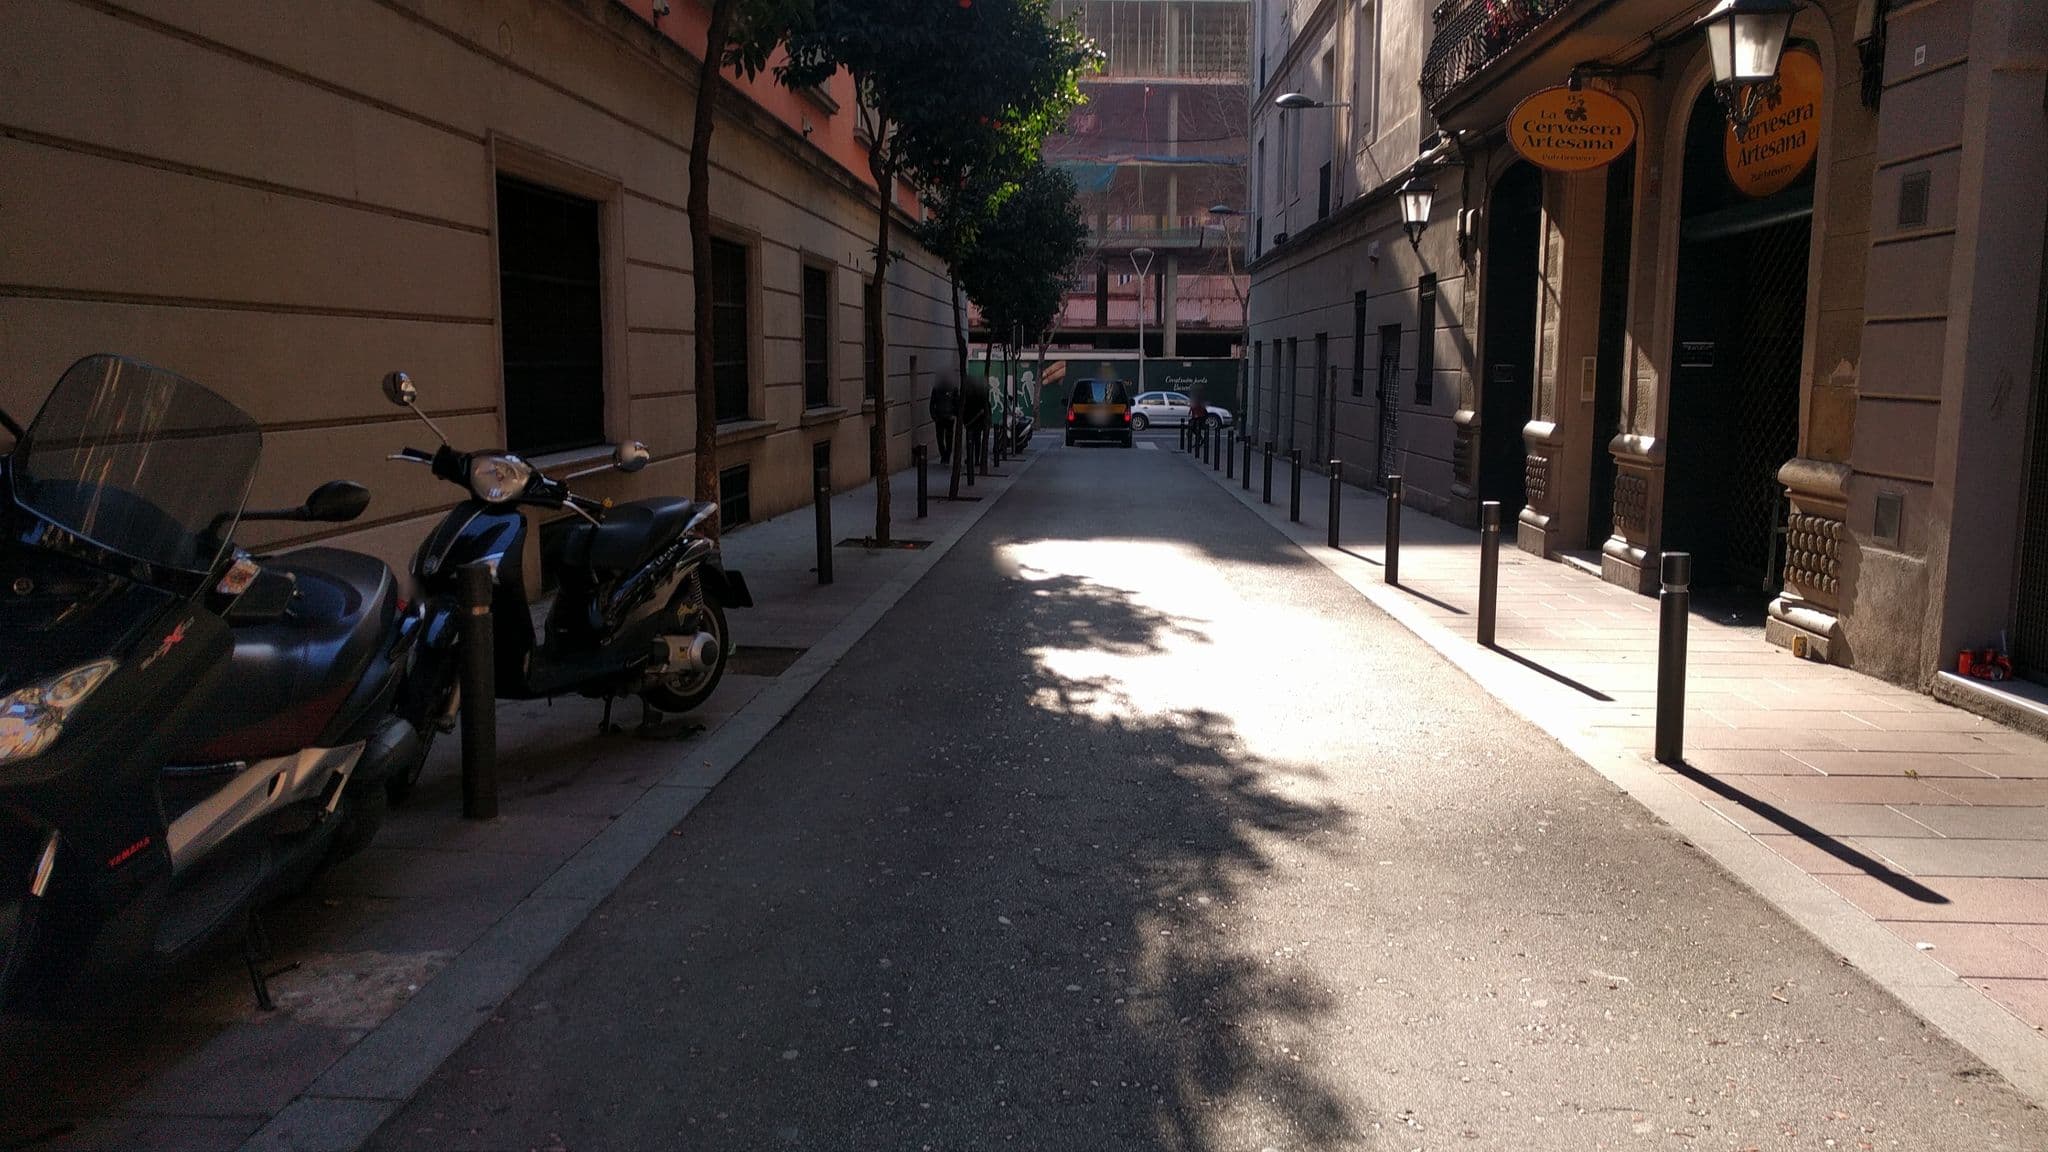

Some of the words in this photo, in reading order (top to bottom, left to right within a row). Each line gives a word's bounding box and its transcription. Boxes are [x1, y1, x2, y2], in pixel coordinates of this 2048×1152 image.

[1540, 110, 1557, 120] La
[1522, 119, 1622, 136] Cervesera
[1522, 134, 1615, 150] Artesana
[1737, 130, 1807, 169] Artesana
[105, 835, 152, 866] YAMAHA
